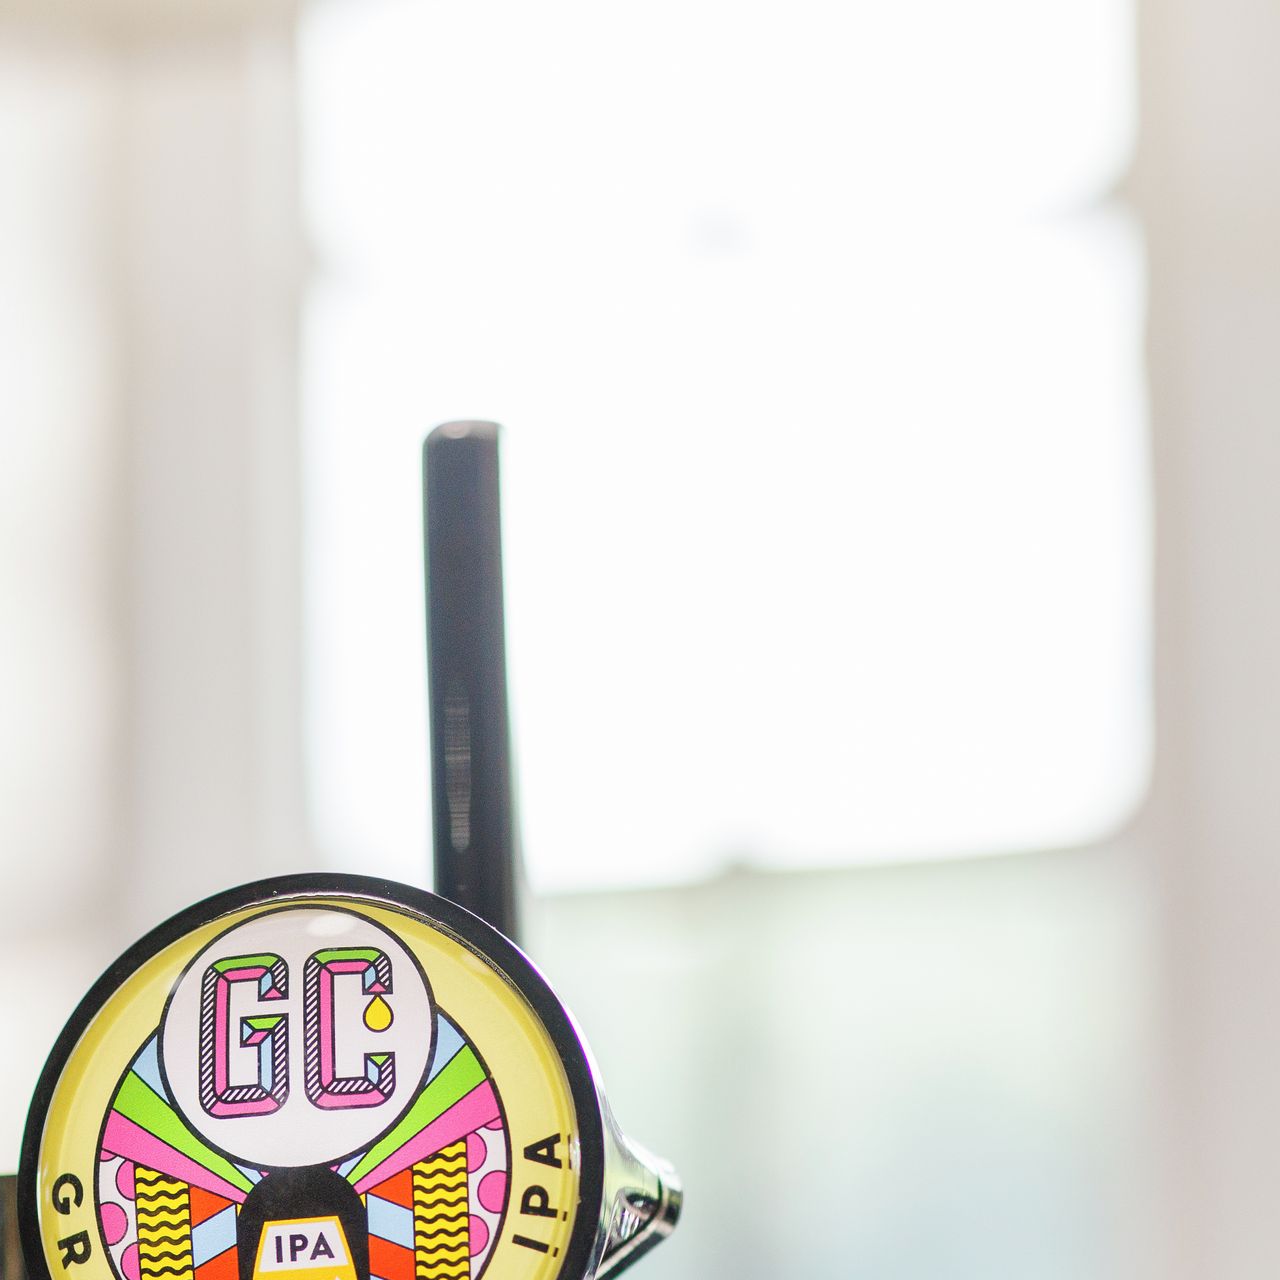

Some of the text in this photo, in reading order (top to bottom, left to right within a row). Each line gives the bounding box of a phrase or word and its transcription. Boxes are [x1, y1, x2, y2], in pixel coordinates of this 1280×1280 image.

[198, 945, 397, 1120] GC
[274, 1235, 336, 1264] IPA
[512, 1131, 563, 1254] IPA
